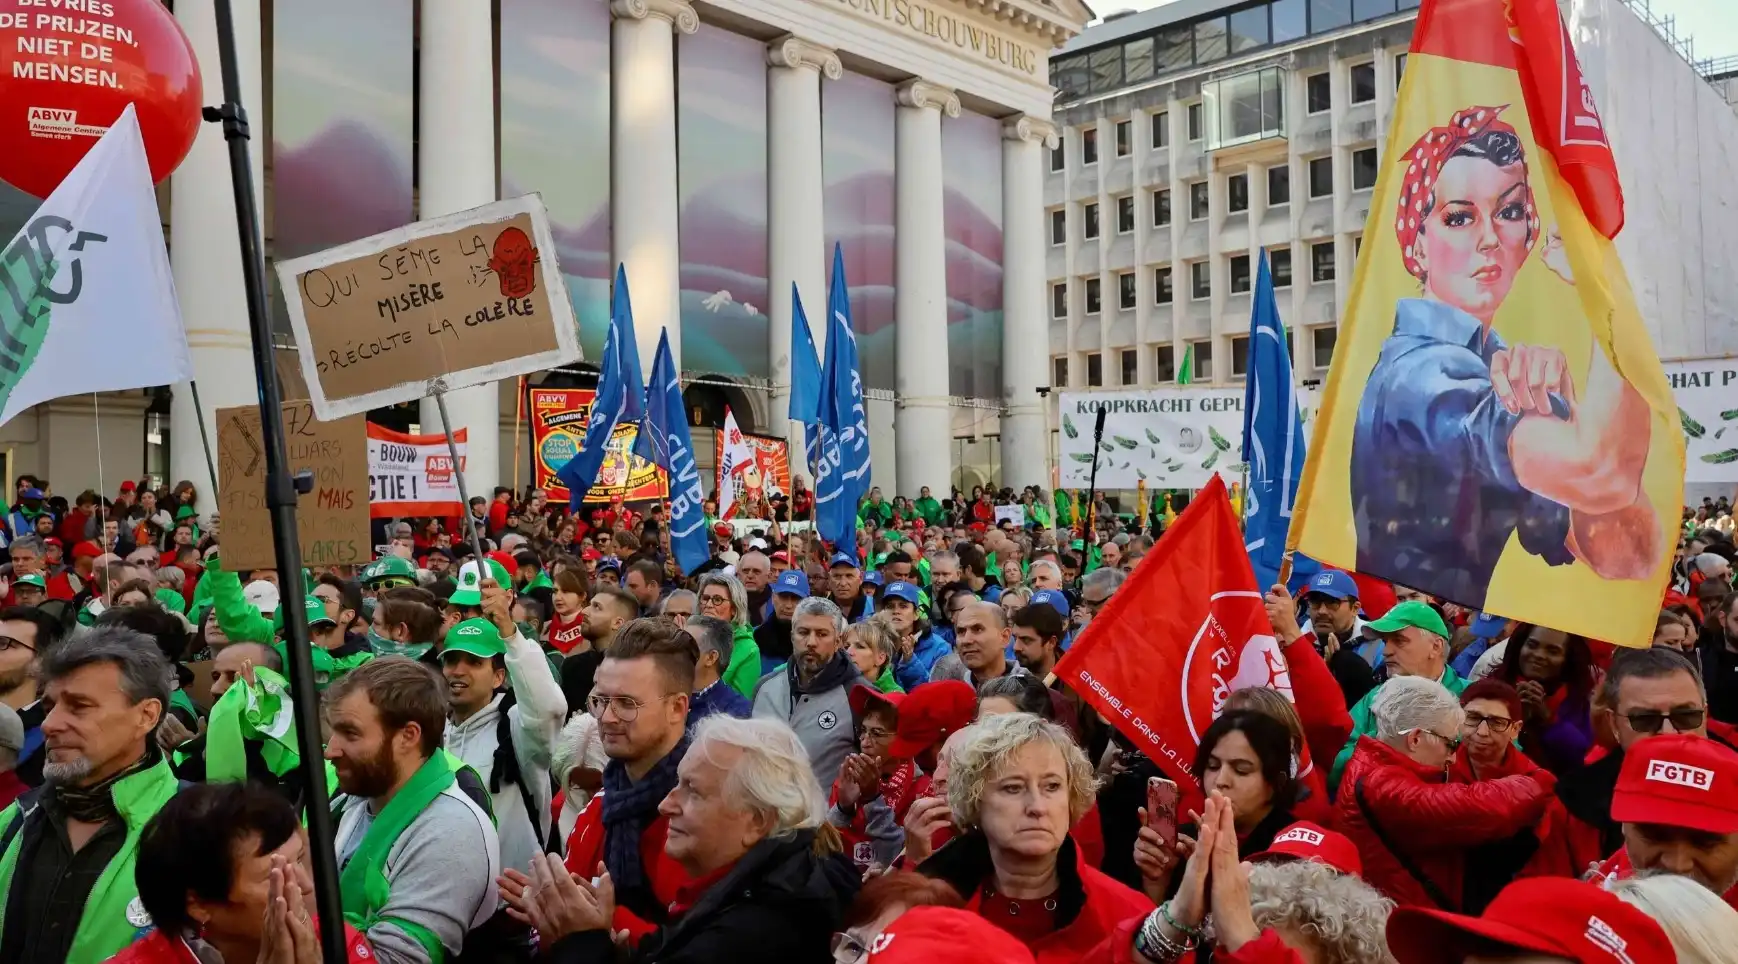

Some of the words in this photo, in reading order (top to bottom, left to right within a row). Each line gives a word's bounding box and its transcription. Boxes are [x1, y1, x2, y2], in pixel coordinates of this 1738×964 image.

[0, 13, 28, 28] DE
[36, 14, 138, 48] PRIJZEN,
[838, 0, 1036, 74] NTSCHOUWBURG
[17, 36, 73, 56] NIET
[81, 42, 112, 63] DE
[13, 61, 123, 89] MENSEN.
[31, 109, 73, 122] ABVV
[32, 123, 72, 133] Algemene
[458, 235, 489, 258] LA
[330, 330, 412, 372] RÉCOLTE
[428, 319, 460, 340] LA
[1665, 371, 1702, 389] HAT
[1077, 398, 1193, 414] KOOPKRACHT
[1200, 397, 1245, 412] GEPL
[283, 403, 316, 436] 72
[549, 412, 581, 424] ALGEMENE
[290, 439, 343, 461] LLIARS
[381, 443, 417, 463] BOUW
[548, 439, 572, 447] STOP
[317, 487, 354, 510] MAIS
[369, 475, 406, 500] CTIE
[412, 476, 417, 499] !
[303, 540, 358, 563] LAIRES
[1211, 616, 1237, 658] RUXELLES
[1079, 670, 1133, 719] ENSEMBLE
[1132, 717, 1161, 745] DANS
[1160, 743, 1177, 760] LA
[1651, 763, 1707, 786] FGTB
